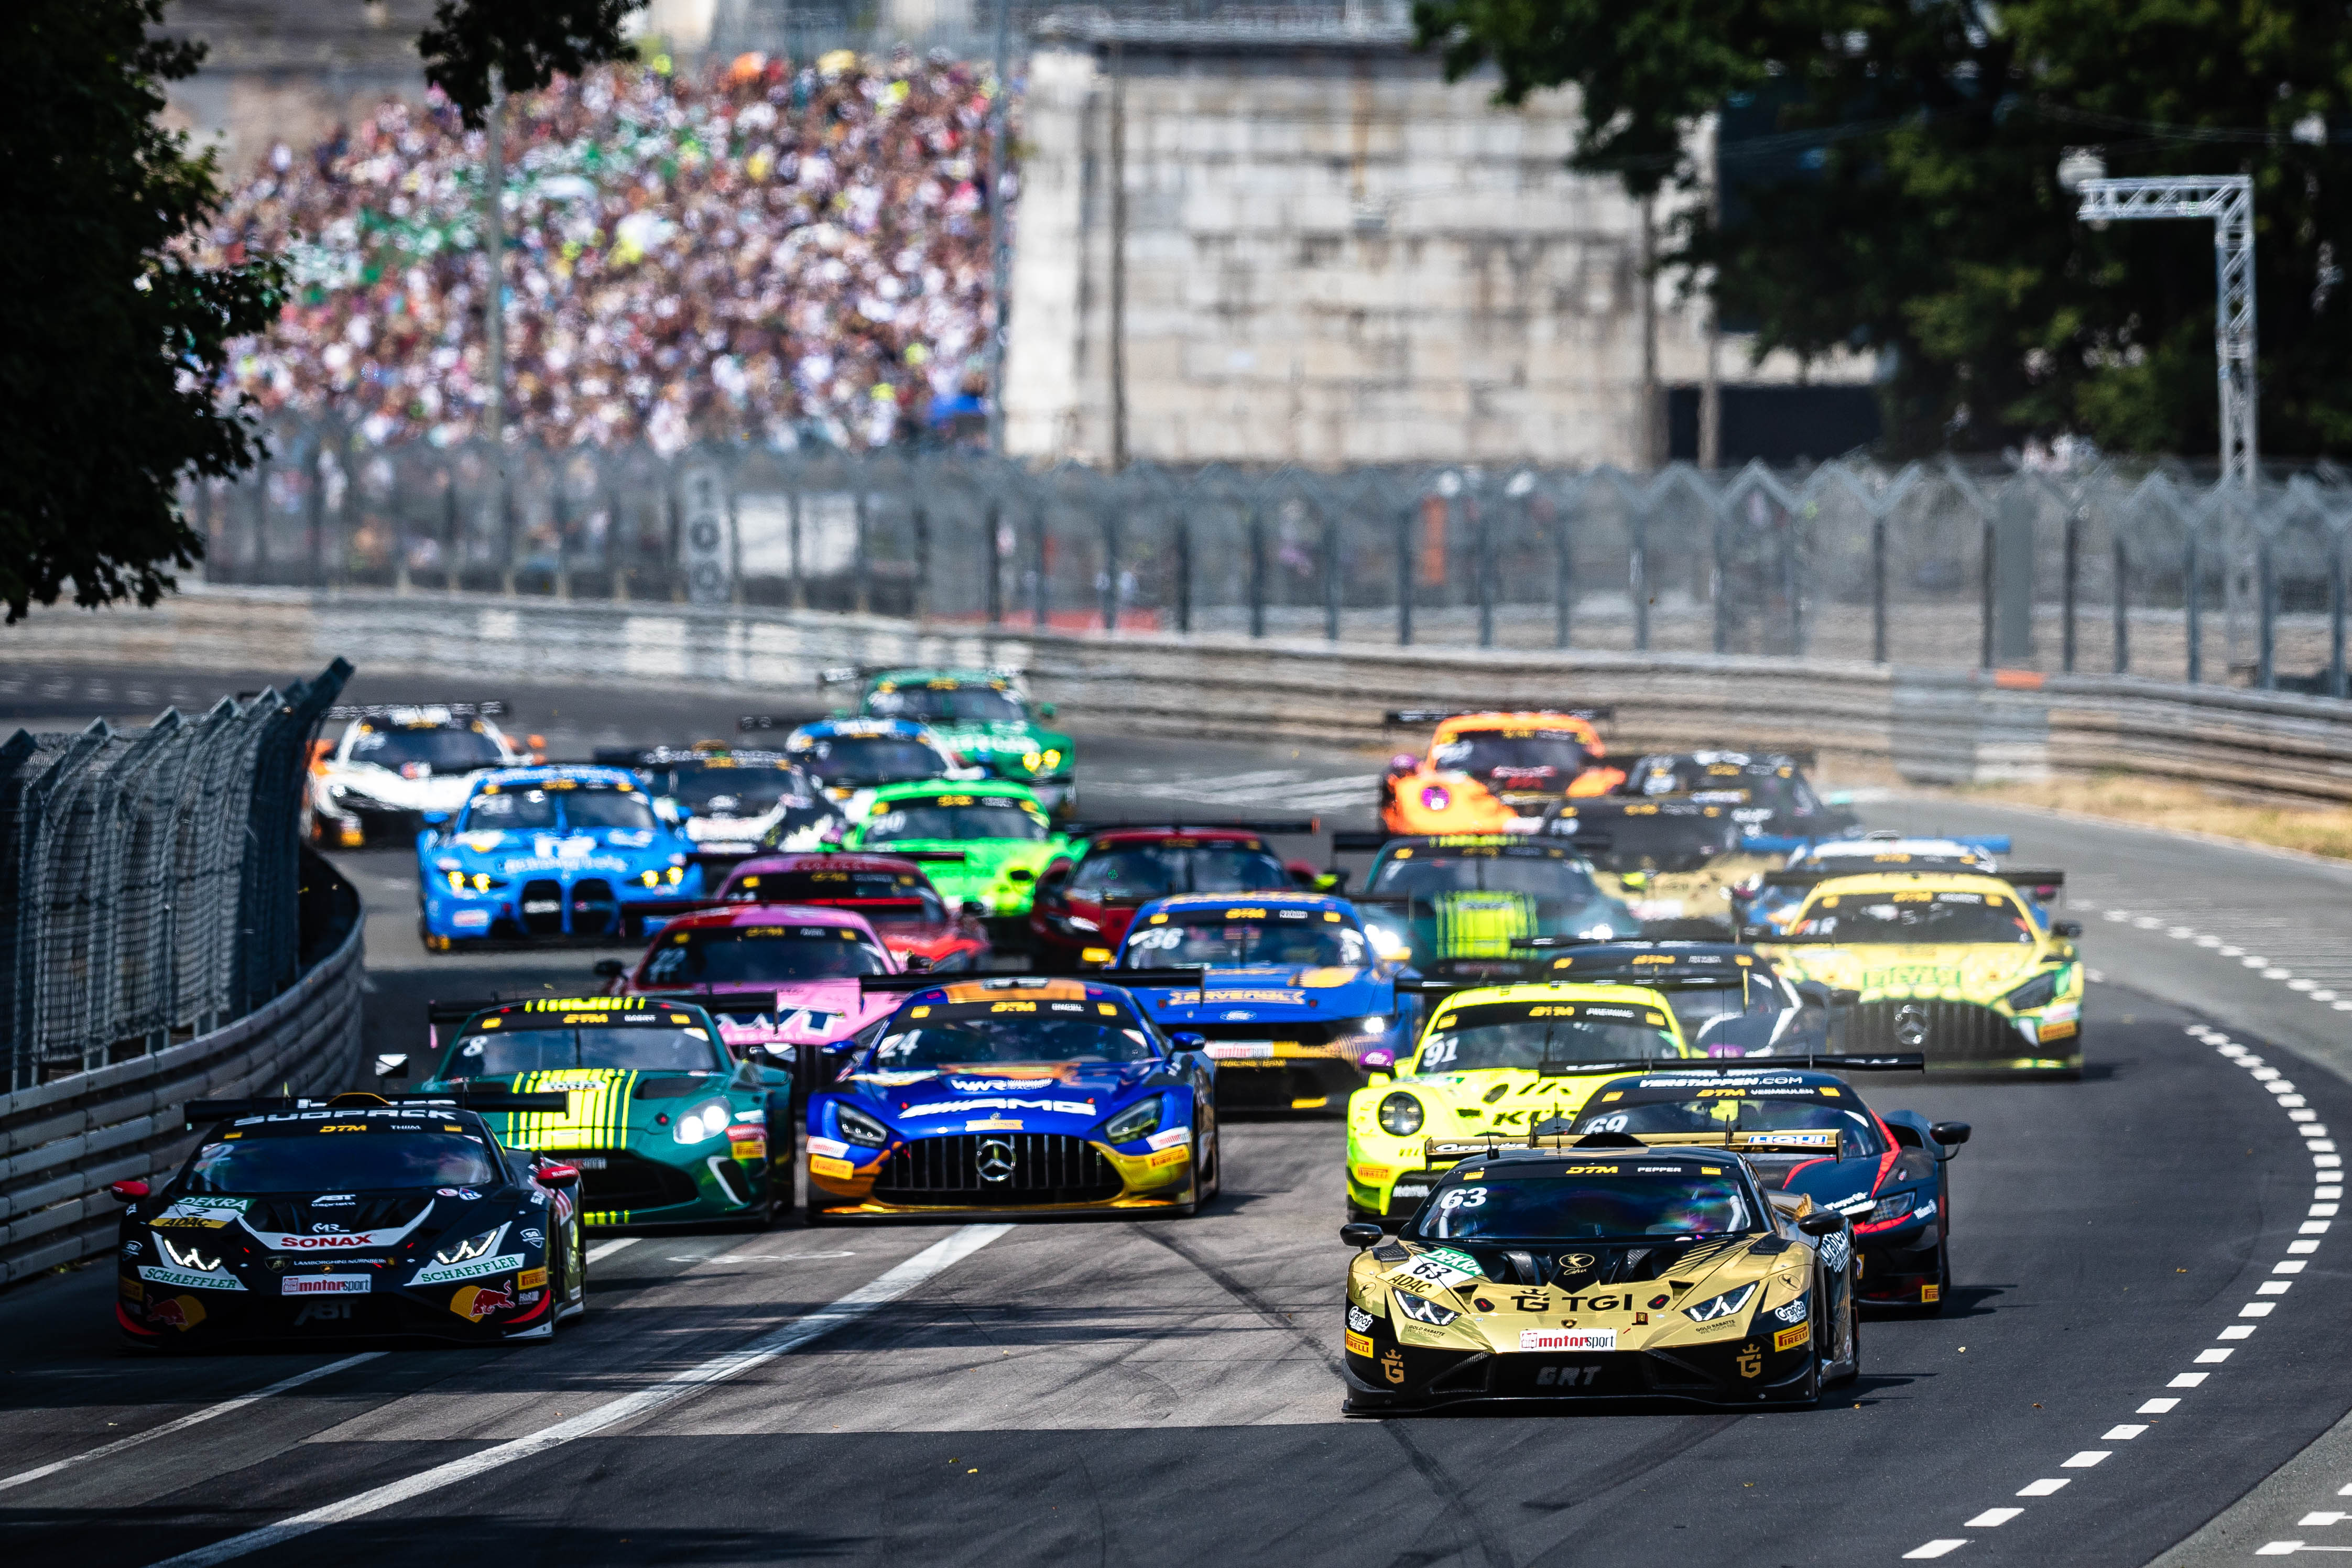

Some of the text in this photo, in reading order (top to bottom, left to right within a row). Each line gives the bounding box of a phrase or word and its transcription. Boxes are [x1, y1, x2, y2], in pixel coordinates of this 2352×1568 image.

[1422, 1037, 1460, 1068] 91
[1639, 1076, 1803, 1087] VERSTAPPEN.COM
[1696, 1088, 1746, 1097] DTM
[177, 1197, 248, 1211] DEKRA
[1441, 1188, 1488, 1210] 63
[186, 1208, 211, 1217] 2
[163, 1218, 212, 1227] ADAC
[280, 1234, 373, 1248] SONAX
[421, 1256, 520, 1282] SCHAEFFLER
[1413, 1262, 1452, 1280] 63
[145, 1268, 236, 1289] SCHAEFFLER
[299, 1279, 369, 1292] motorsport
[1387, 1274, 1432, 1293] ADAC
[1562, 1294, 1633, 1312] TGI
[1423, 1328, 1445, 1336] RABATTE
[1779, 1326, 1807, 1347] PIRELLI
[1347, 1333, 1369, 1353] PIRELLI
[1539, 1336, 1614, 1348] motorsport
[1536, 1366, 1602, 1386] GRT
